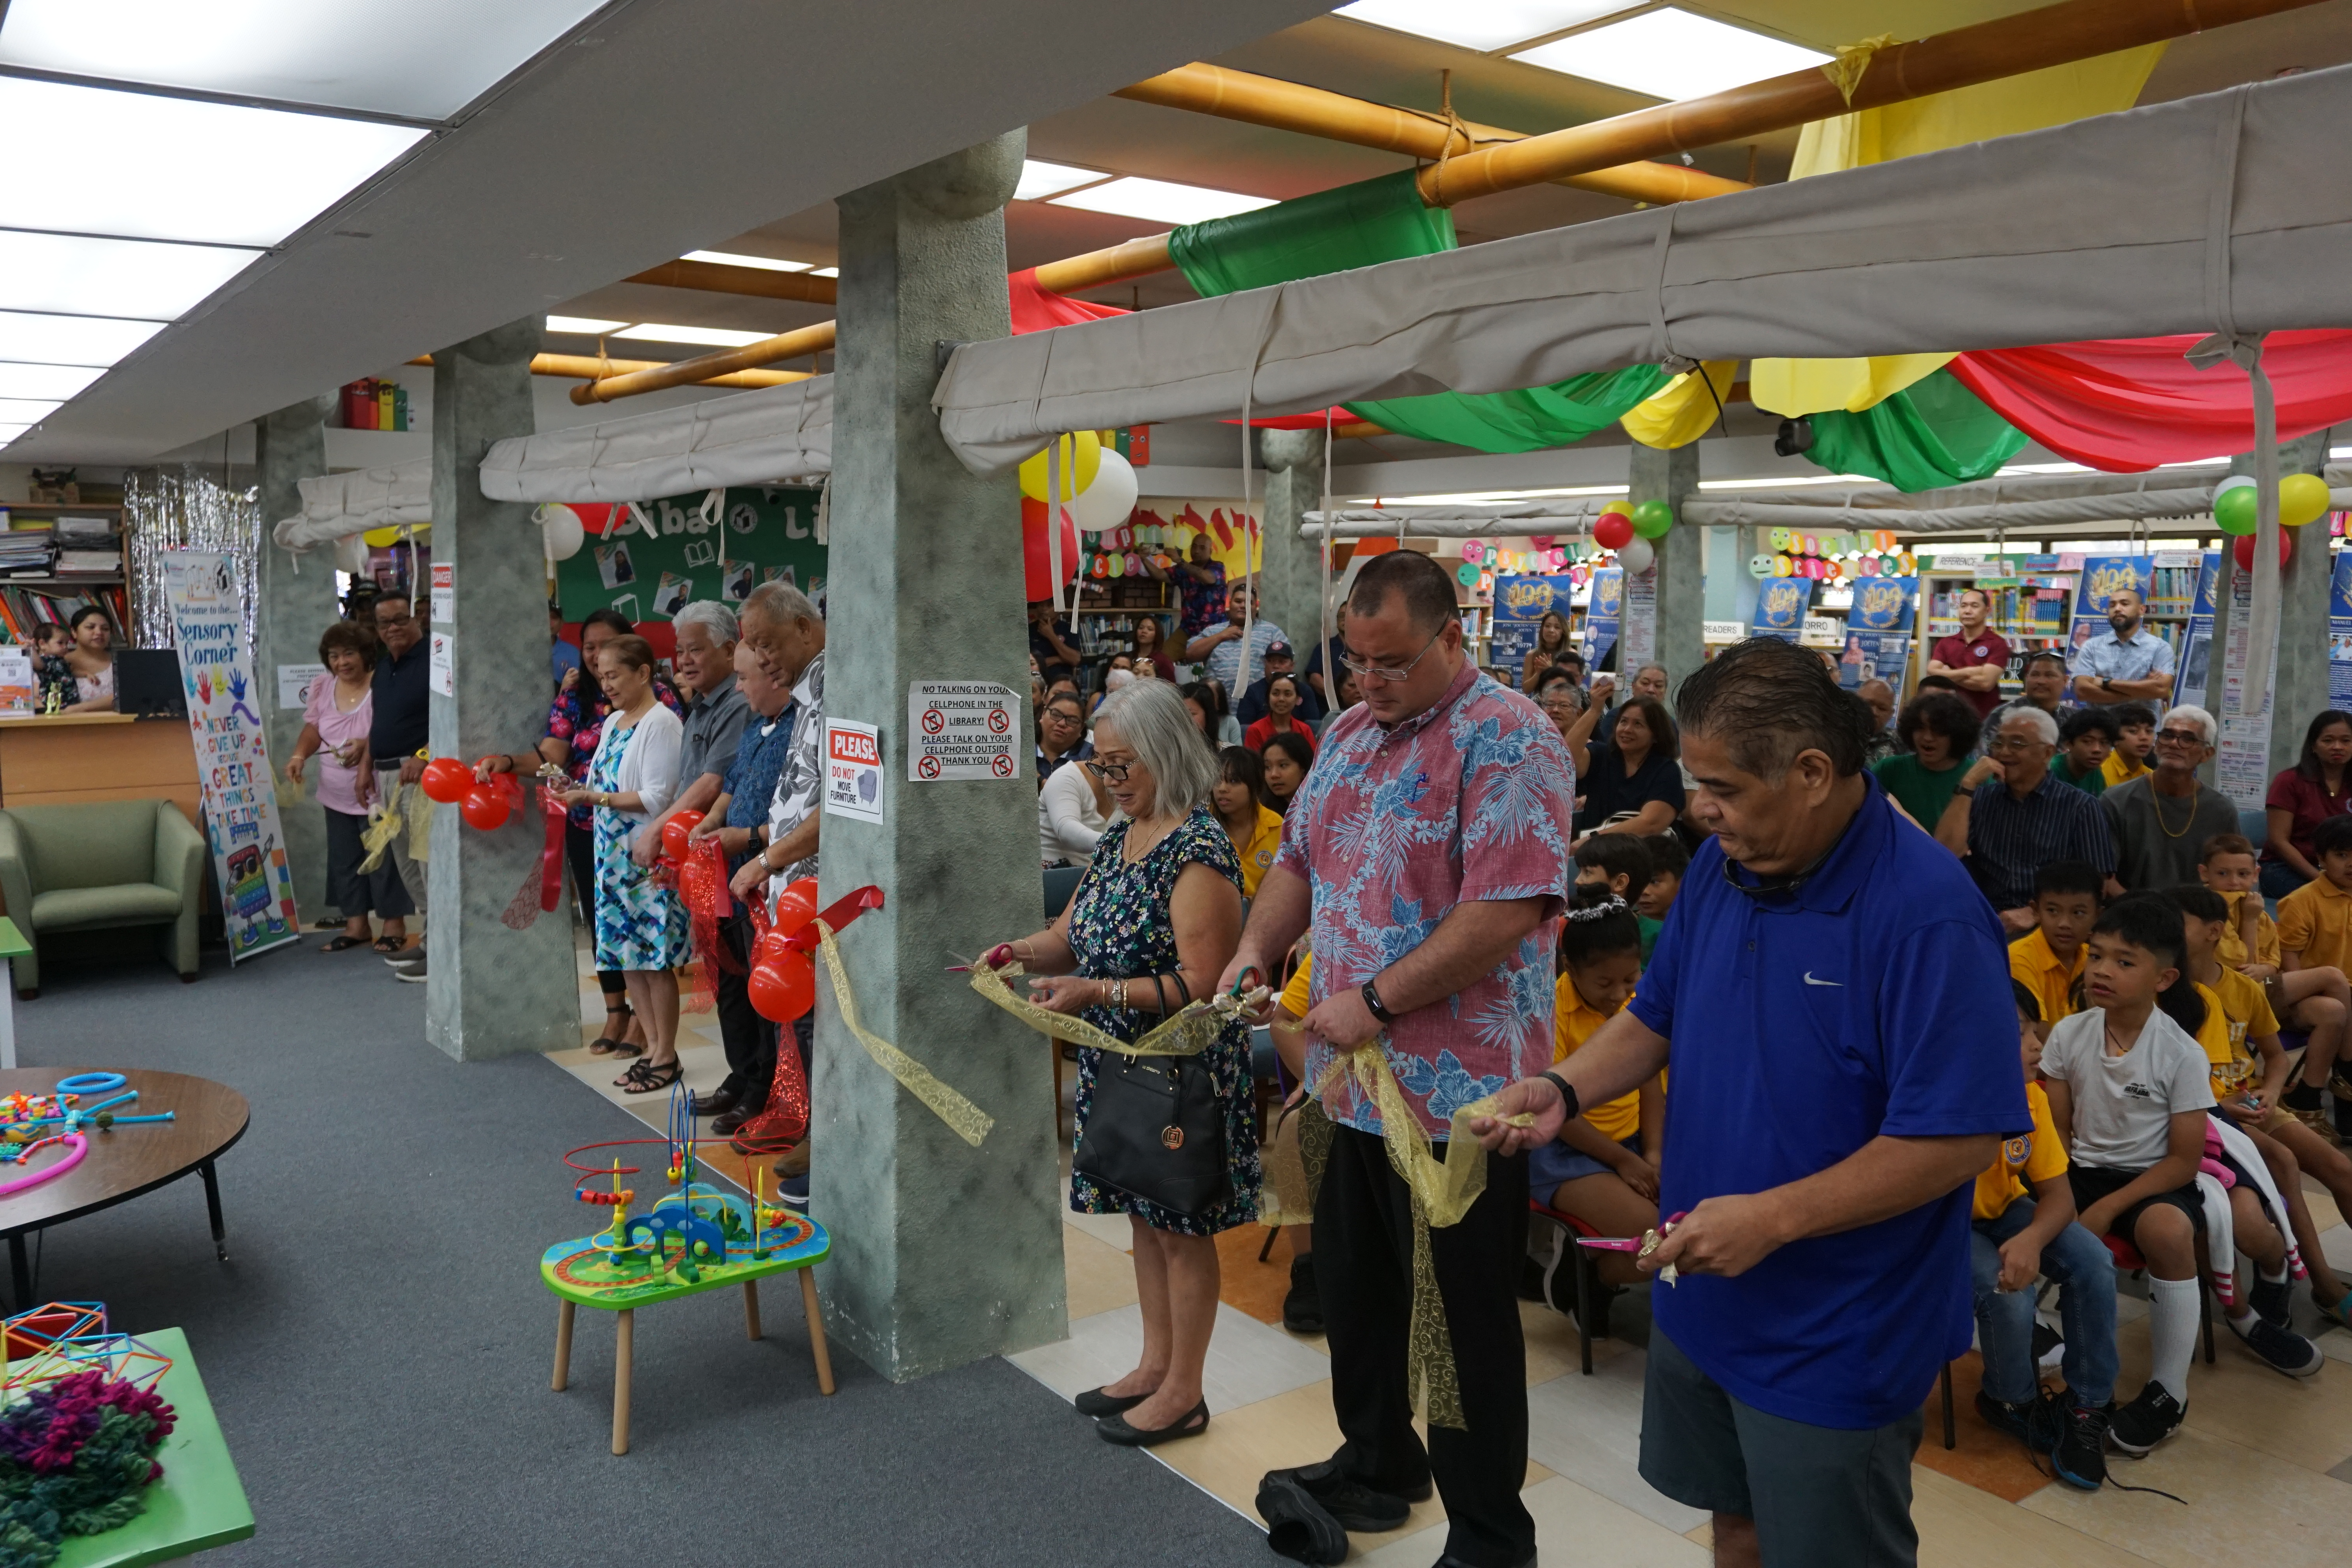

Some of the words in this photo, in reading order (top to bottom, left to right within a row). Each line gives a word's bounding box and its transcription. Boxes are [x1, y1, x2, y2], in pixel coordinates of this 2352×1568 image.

[1940, 557, 1978, 566] REFERENCE
[433, 571, 451, 583] DANGER
[174, 603, 207, 614] Welcome
[210, 605, 216, 614] to
[177, 617, 237, 646] Sensory
[1704, 625, 1737, 634] READERS
[1805, 621, 1828, 631] ORRO
[185, 642, 238, 665] Corner
[207, 716, 240, 734] NEVER
[208, 736, 229, 753] GIVE
[232, 733, 246, 749] UP
[835, 735, 875, 760] PLEASE
[212, 762, 253, 789] GREAT
[832, 766, 841, 778] DO
[843, 768, 855, 780] NOT
[838, 780, 851, 792] MOVE
[219, 788, 254, 808] THINGS
[831, 790, 856, 804] FURNITURE
[216, 810, 238, 828] TAKE
[240, 804, 267, 822] TIME
